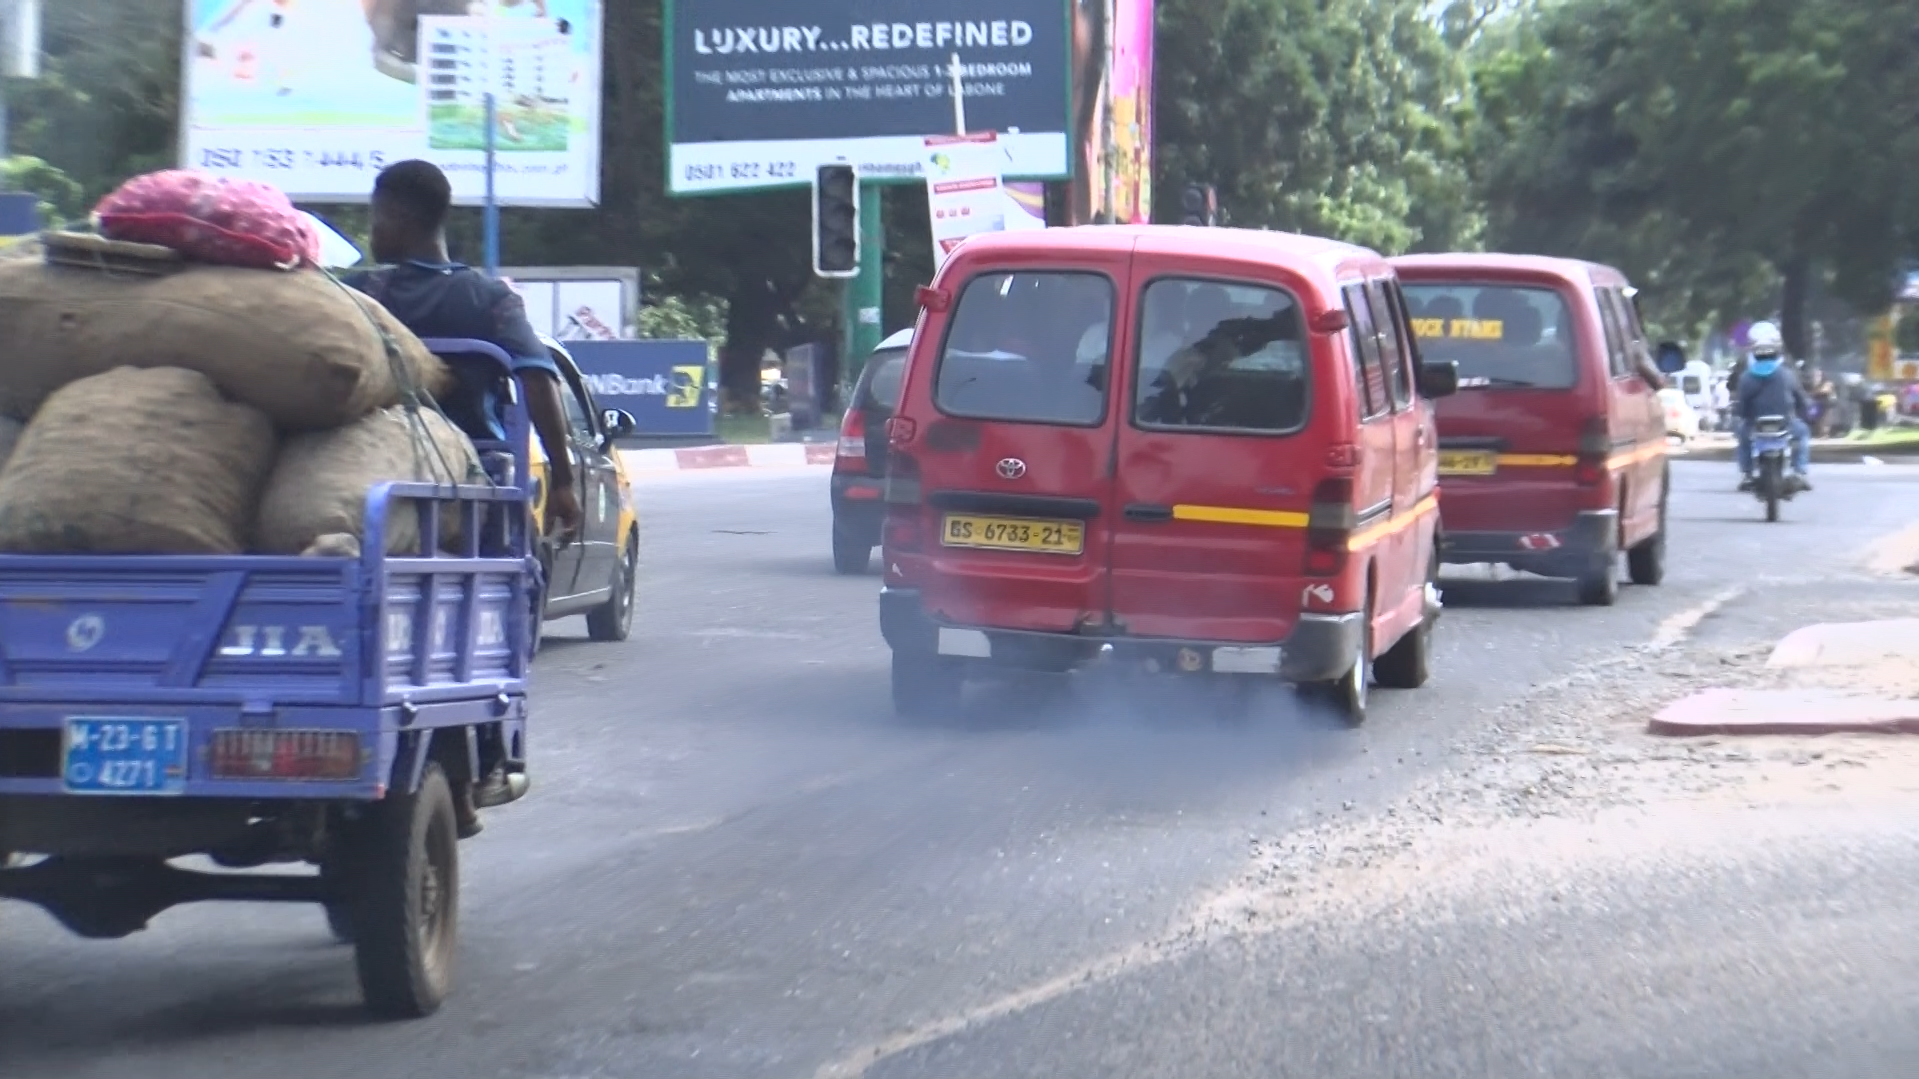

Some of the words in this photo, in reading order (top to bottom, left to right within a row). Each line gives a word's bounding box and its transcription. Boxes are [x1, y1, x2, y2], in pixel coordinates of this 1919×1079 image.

[694, 20, 1033, 55] LUXURY...REDEFINED
[695, 70, 723, 85] THE
[725, 69, 766, 84] MOST
[768, 67, 844, 83] EXCLUSIVE
[861, 64, 931, 82] SPACIOUS
[725, 86, 823, 102] APARTMENTS
[825, 85, 842, 100] IN
[845, 84, 871, 100] THE
[875, 83, 920, 98] HEART
[923, 82, 944, 97] OF
[100, 760, 155, 786] 4271
